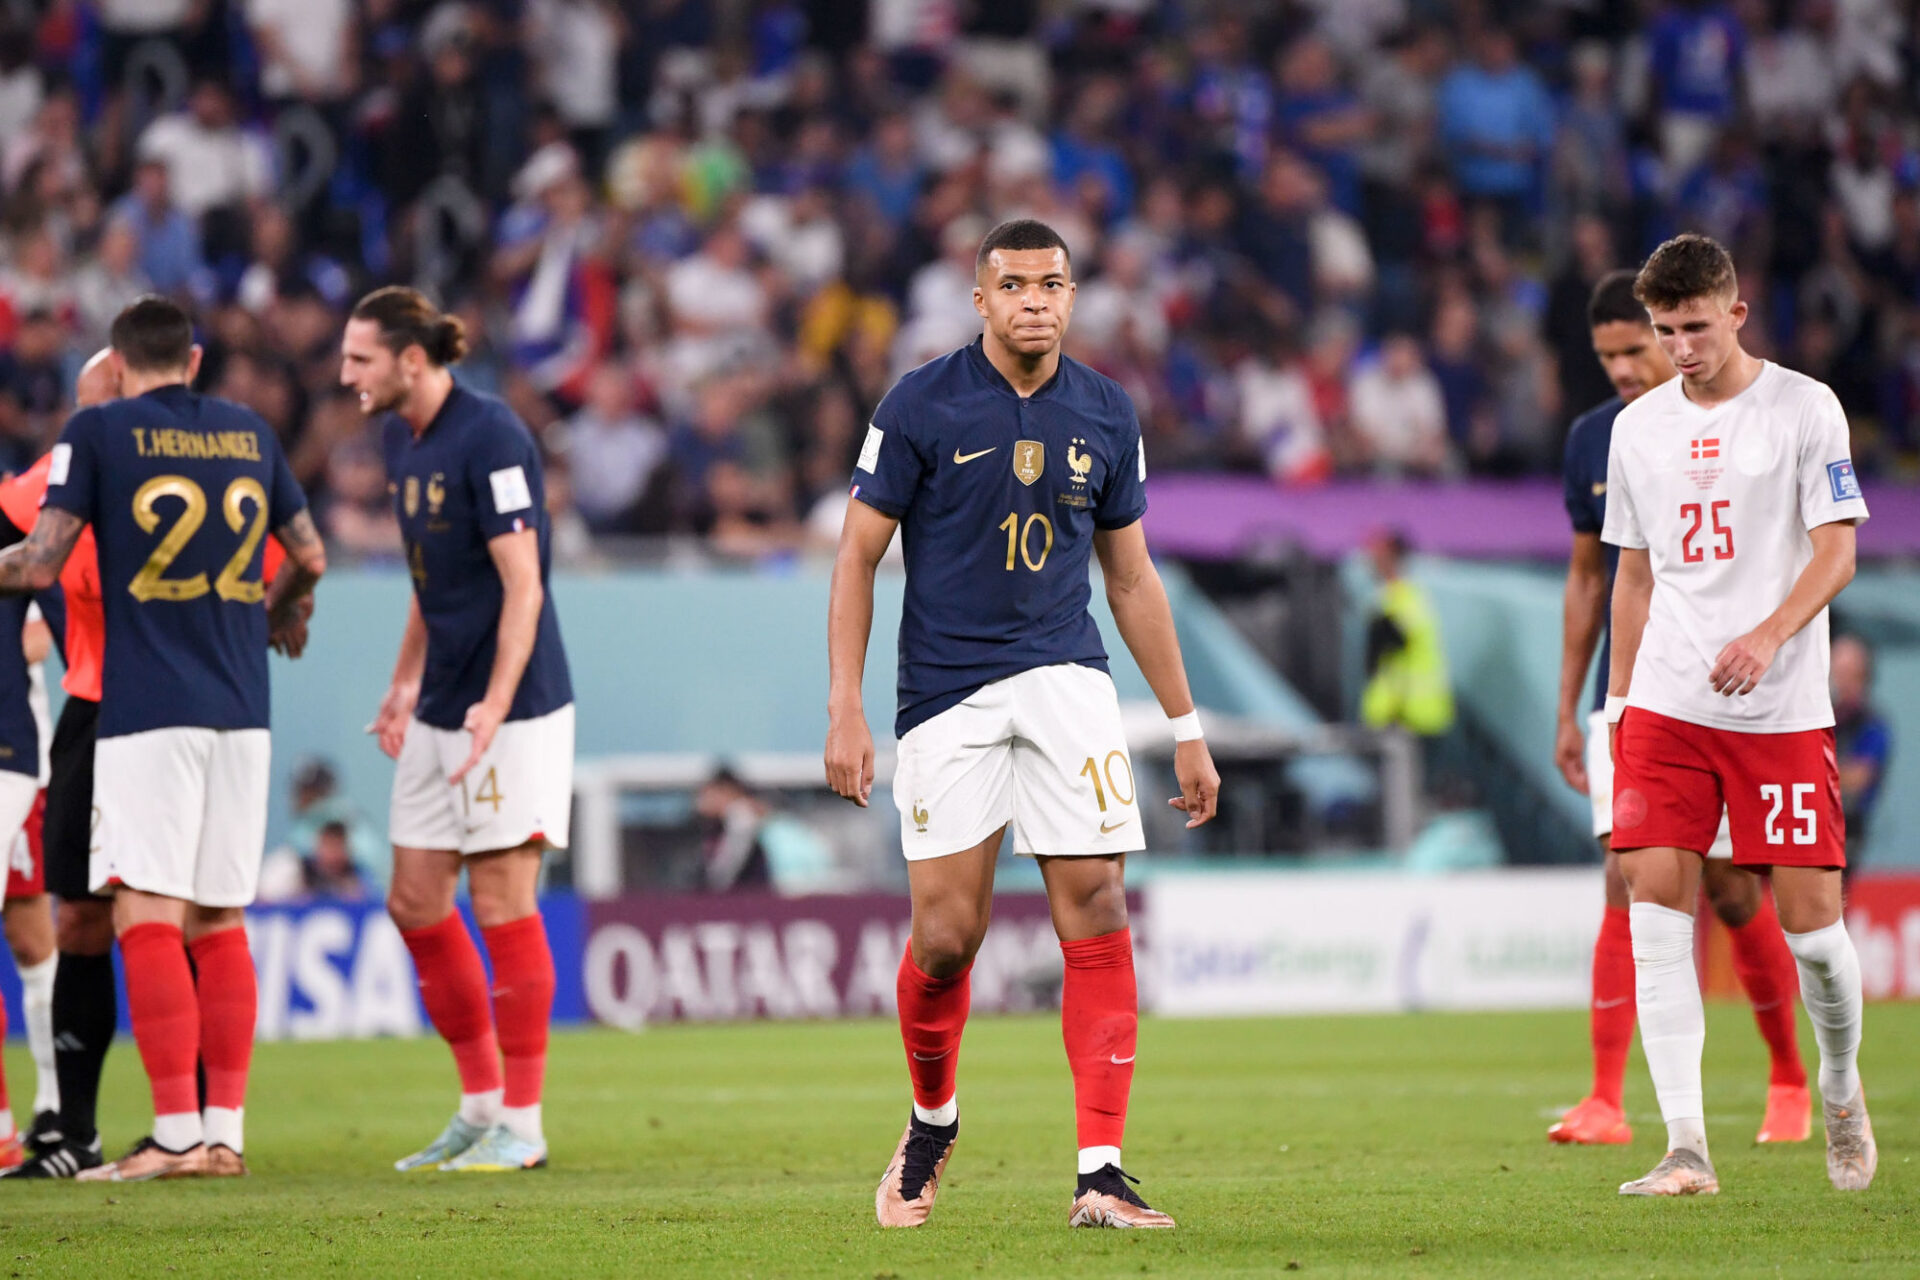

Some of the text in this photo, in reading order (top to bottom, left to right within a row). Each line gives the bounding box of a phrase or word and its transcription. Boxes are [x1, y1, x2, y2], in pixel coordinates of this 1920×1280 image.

[128, 474, 266, 604] 22
[999, 512, 1054, 571] 10
[1680, 500, 1735, 563] 25
[1080, 750, 1135, 812] 10
[1760, 783, 1817, 845] 25
[245, 906, 425, 1040] ISA
[583, 920, 846, 1033] QATAR
